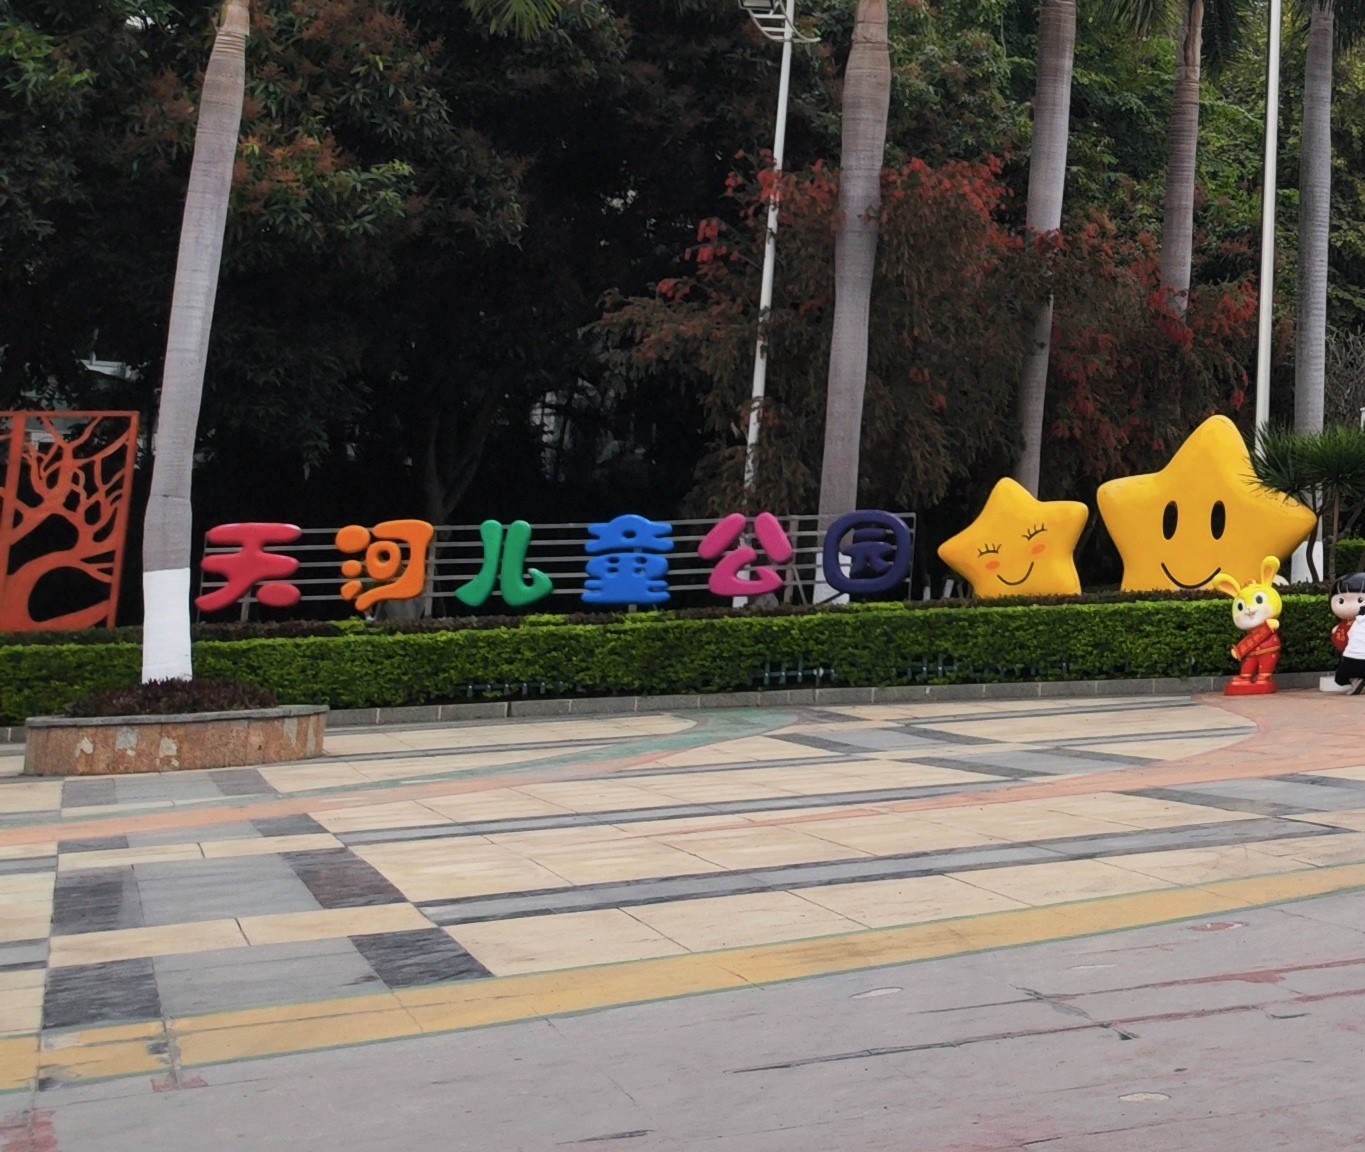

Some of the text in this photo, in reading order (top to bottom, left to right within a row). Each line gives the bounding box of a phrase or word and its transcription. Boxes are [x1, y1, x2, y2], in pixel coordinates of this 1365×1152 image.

[195, 509, 914, 612] 天河儿童公园
